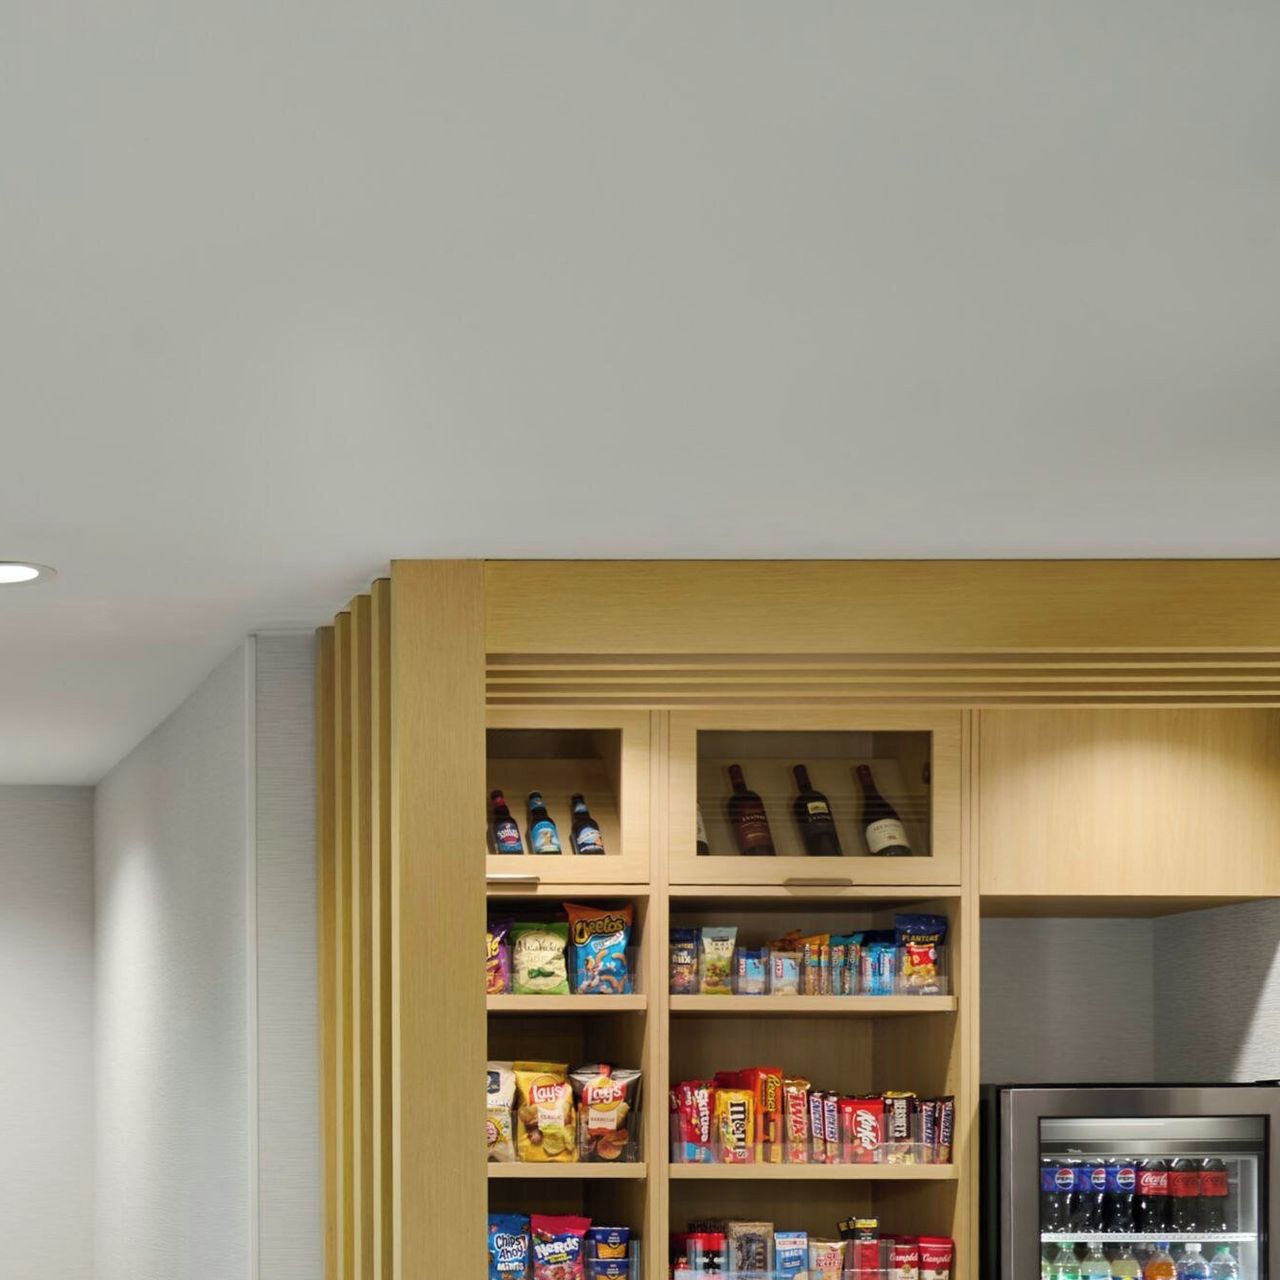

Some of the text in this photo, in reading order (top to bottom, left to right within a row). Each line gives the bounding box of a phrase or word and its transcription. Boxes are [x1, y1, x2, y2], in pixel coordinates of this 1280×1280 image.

[575, 915, 624, 944] Cheetos
[533, 1083, 566, 1104] Lay's
[588, 1084, 622, 1104] Lay's
[496, 1234, 521, 1249] Chips
